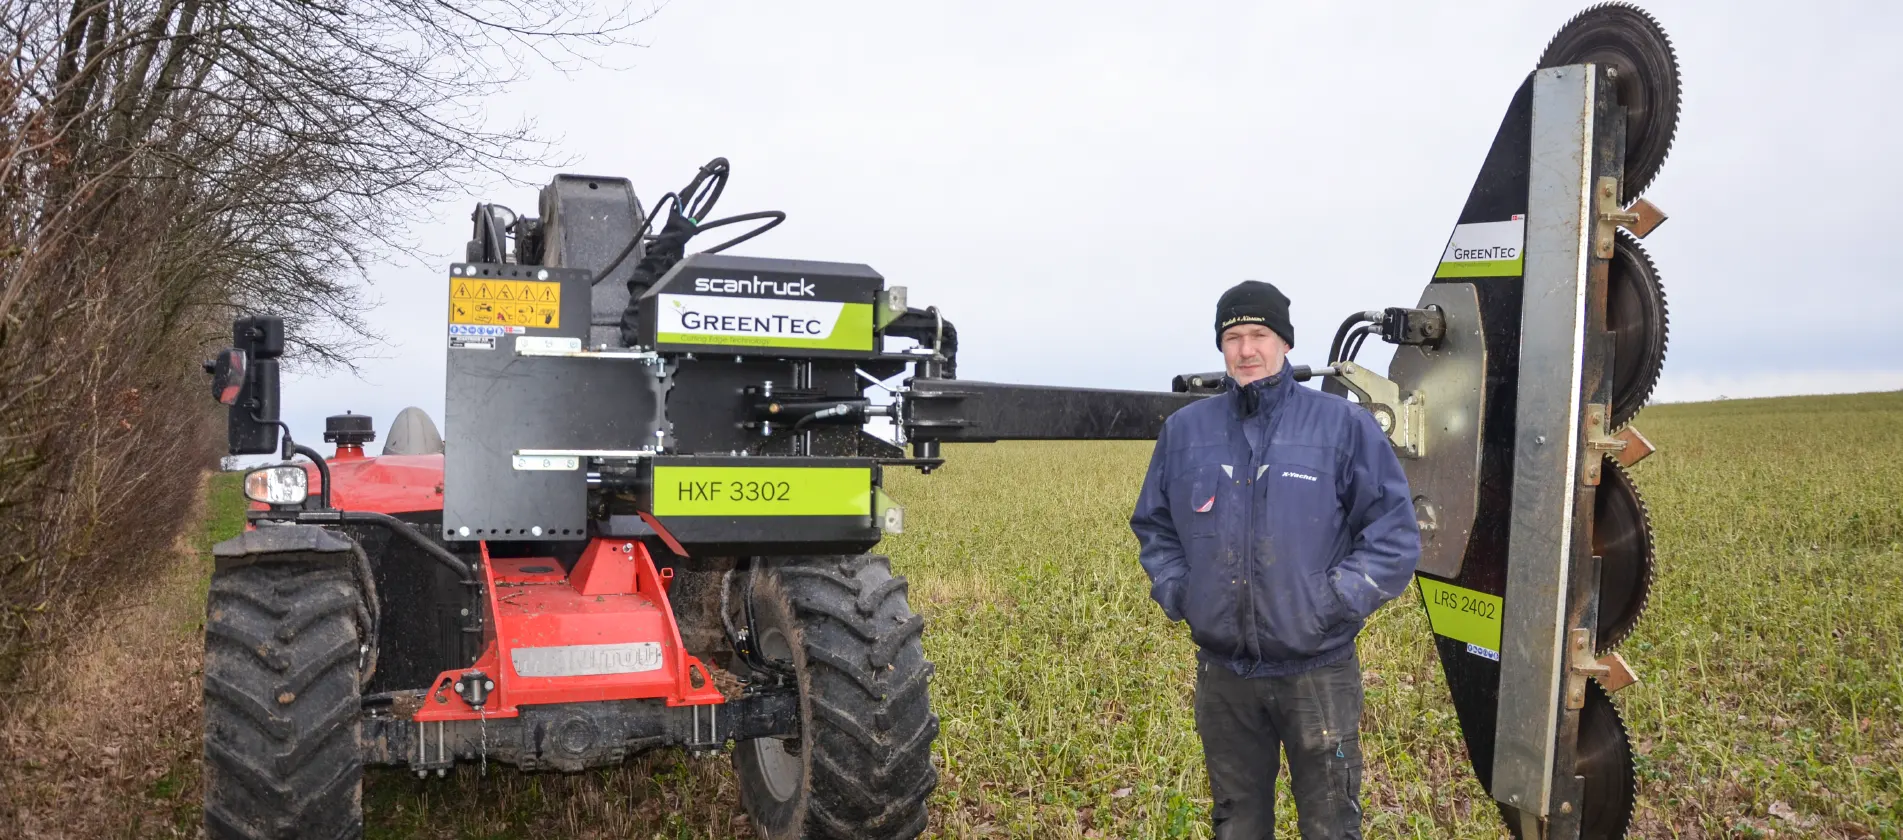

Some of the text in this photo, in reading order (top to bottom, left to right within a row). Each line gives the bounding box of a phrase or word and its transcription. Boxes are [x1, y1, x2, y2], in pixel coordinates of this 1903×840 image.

[695, 275, 815, 297] scantruck
[680, 334, 771, 345] Cutting Edge Technology
[1282, 471, 1317, 482] X-Yachts
[678, 481, 790, 501] HXF 3302
[1434, 588, 1495, 620] LRS 2402
